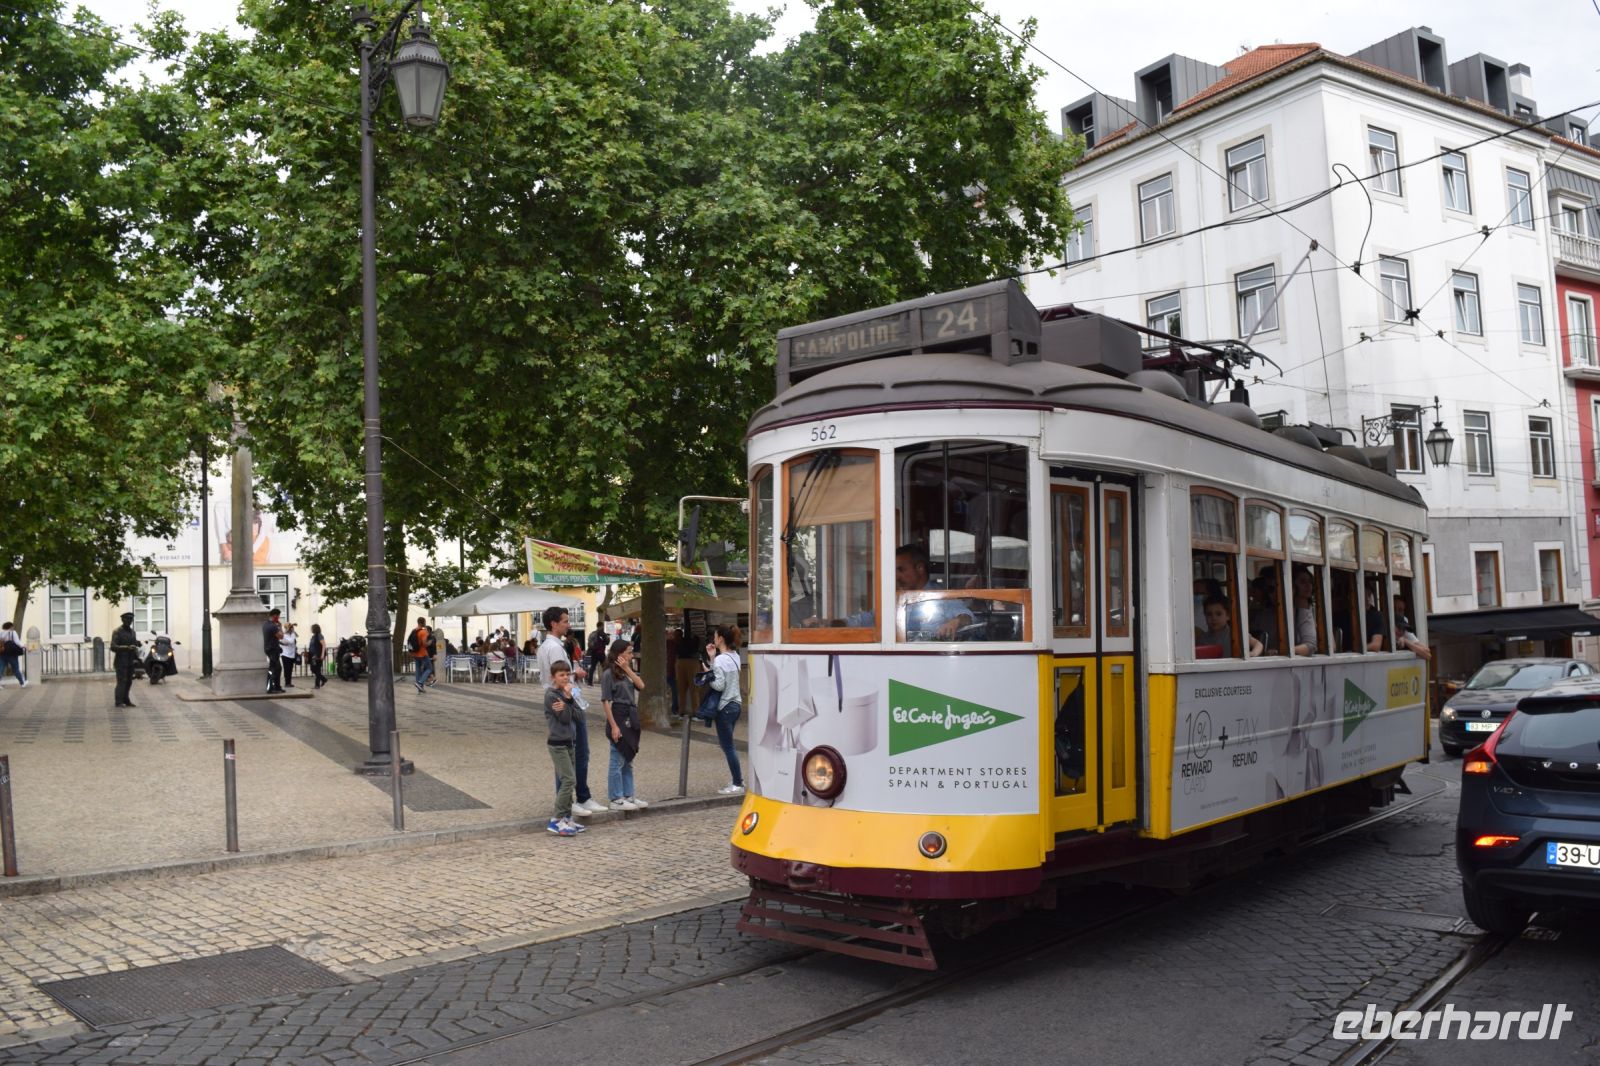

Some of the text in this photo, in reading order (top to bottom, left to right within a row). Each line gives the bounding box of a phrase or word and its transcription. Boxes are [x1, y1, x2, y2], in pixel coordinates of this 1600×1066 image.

[936, 302, 978, 338] 24
[811, 425, 837, 441] 562
[1194, 685, 1252, 699] EXCLUSIVE COURTESIES
[893, 704, 996, 730] El Corte Inglés
[889, 766, 1027, 776] DEPARTMENT STORES
[1182, 751, 1258, 778] REWARD REFUND
[889, 779, 1028, 789] SPAIN & PORTUGAL
[1184, 777, 1207, 795] CARD
